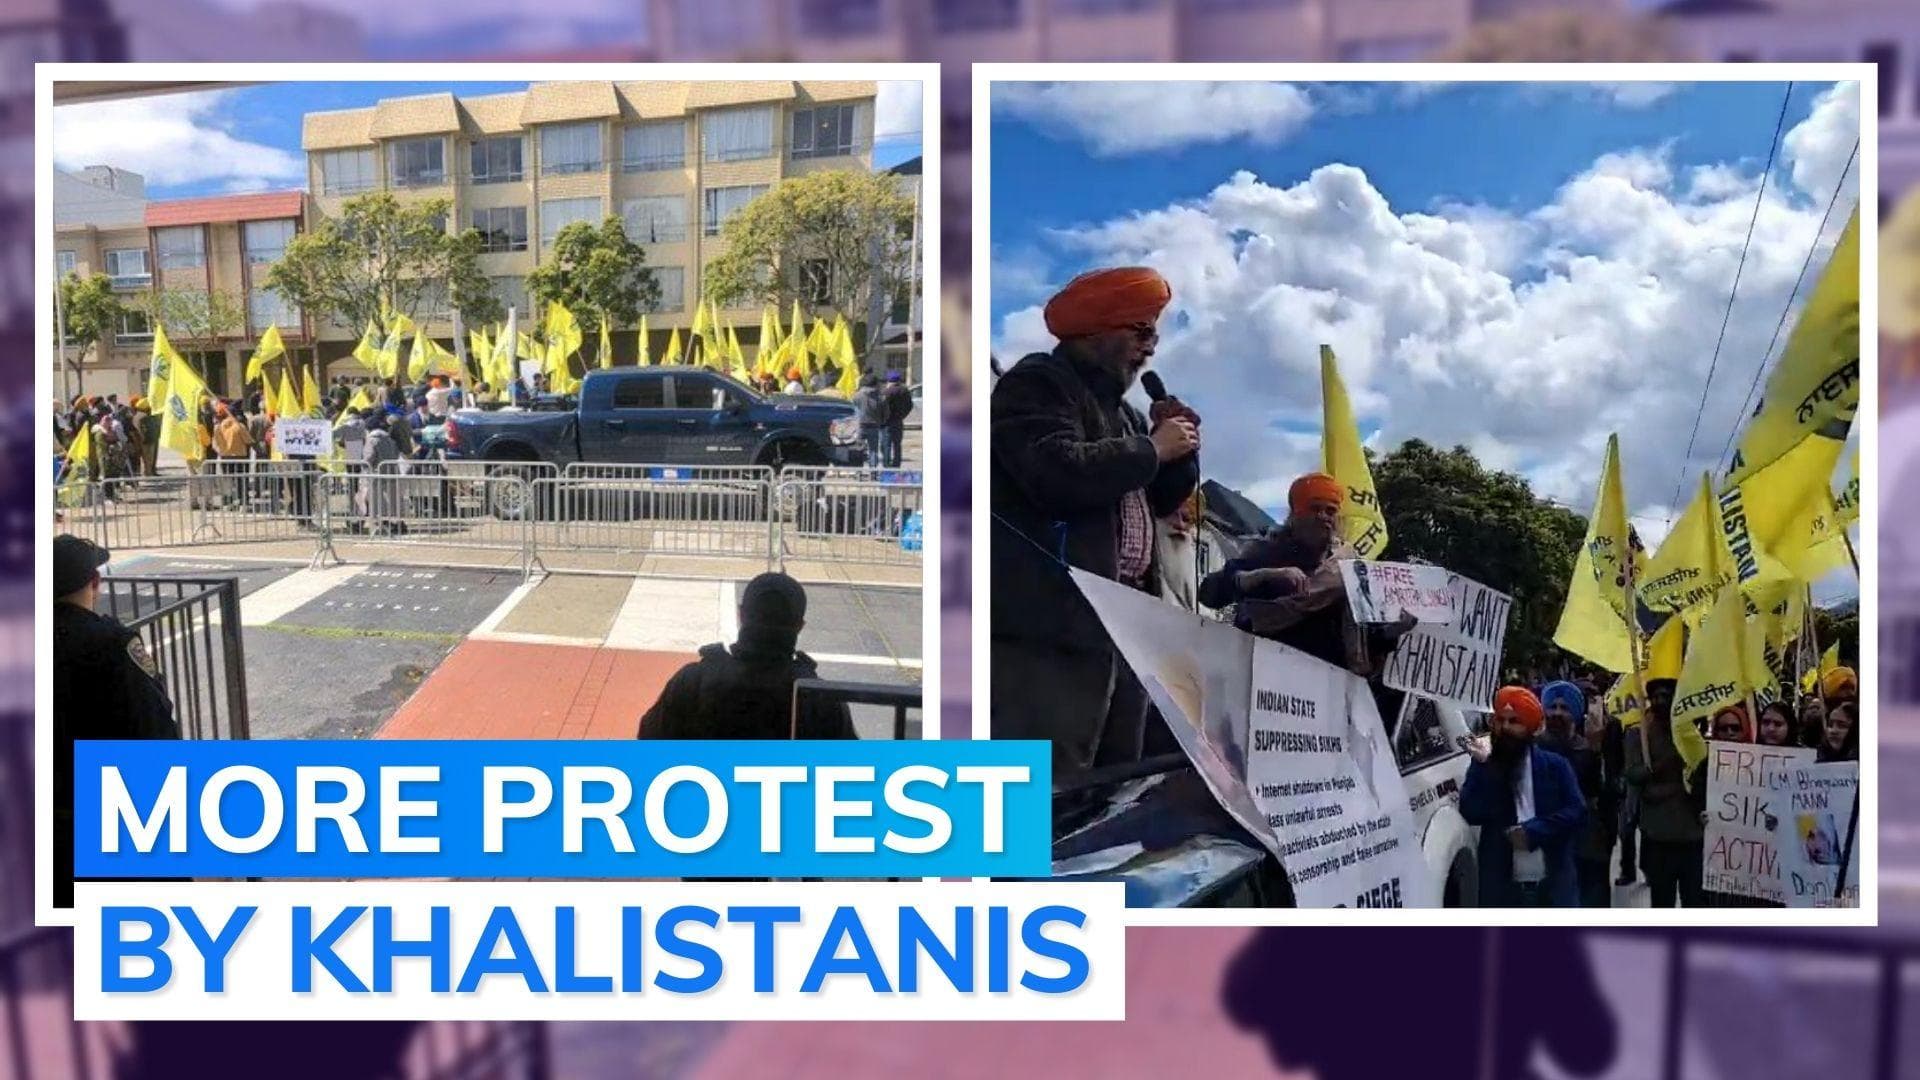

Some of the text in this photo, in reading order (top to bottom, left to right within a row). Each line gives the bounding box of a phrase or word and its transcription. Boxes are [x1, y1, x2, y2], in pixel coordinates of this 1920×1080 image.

[1460, 583, 1511, 650] WANT
[1388, 632, 1497, 708] KHALISTAN
[1256, 689, 1316, 719] INDIAN STATE
[1255, 729, 1318, 753] SUPPRESSING
[1261, 782, 1291, 799] Internet
[1316, 803, 1344, 821] arrests
[1718, 792, 1770, 828] SIK
[1319, 821, 1357, 846] abducted
[1356, 820, 1368, 837] by
[1341, 850, 1356, 867] and
